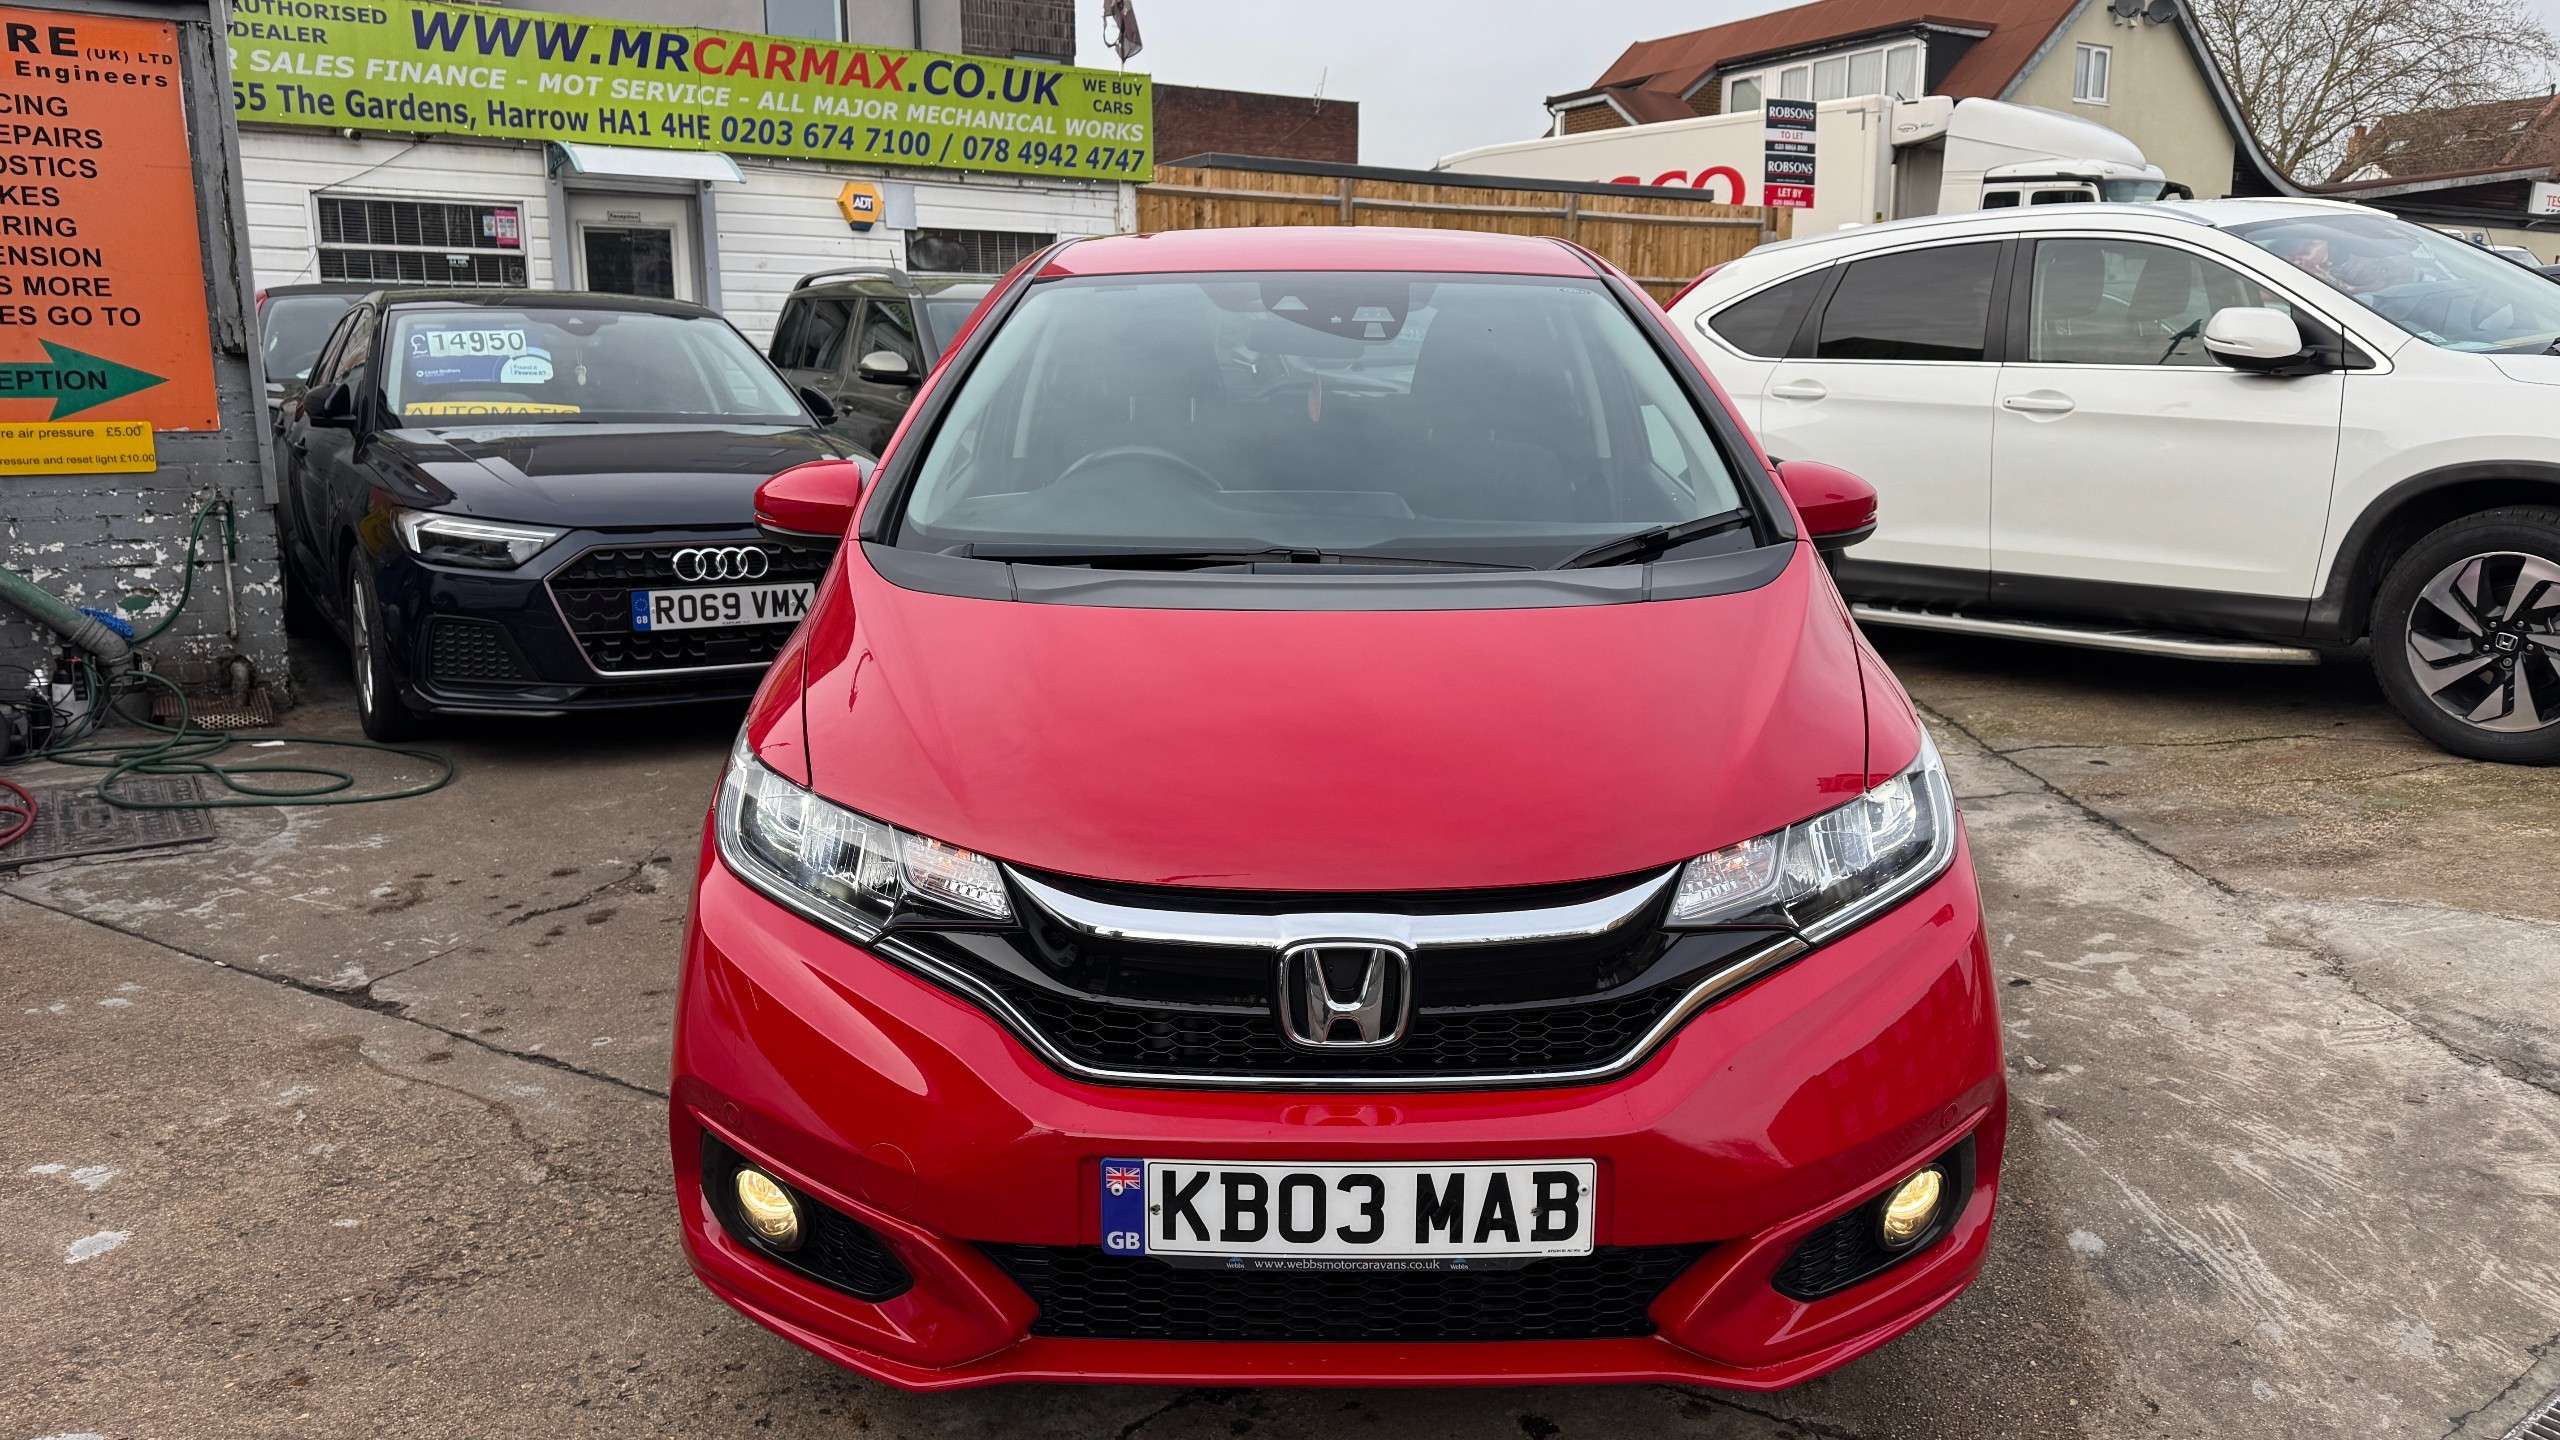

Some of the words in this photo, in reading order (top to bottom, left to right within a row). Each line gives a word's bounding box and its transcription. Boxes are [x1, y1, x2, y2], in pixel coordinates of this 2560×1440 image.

[232, 0, 387, 25] AUTHORISED
[233, 21, 328, 44] DEALER
[6, 22, 79, 58] RE
[86, 48, 129, 64] (UK)
[138, 53, 173, 65] LTD
[412, 9, 1064, 106] WWW.MRCARMAX.CO.UK
[15, 60, 168, 87] Engineers
[250, 49, 355, 78] SALES
[366, 58, 507, 90] FINANCE
[538, 72, 604, 97] MOT
[610, 78, 731, 107] SERVICE
[756, 91, 805, 113] ALL
[813, 95, 898, 121] MAJOR
[906, 104, 1057, 135] MECHANICAL
[1065, 118, 1144, 142] WORKS
[1082, 78, 1107, 93] WE
[1112, 82, 1142, 96] BUY
[0, 93, 68, 117] CING
[1093, 99, 1133, 115] CARS
[1769, 106, 1814, 120] ROBSONS
[0, 124, 103, 149] EPAIRS
[232, 81, 266, 111] 55
[276, 84, 335, 115] The
[345, 89, 477, 131] Gardens,
[487, 100, 589, 132] Harrow
[598, 107, 651, 136] HA1
[661, 112, 711, 140] 4HE
[721, 116, 794, 146] 0203
[803, 123, 855, 151] 674
[865, 127, 931, 156] 7100
[963, 135, 1010, 163] 078
[1017, 141, 1078, 168] 4942
[1085, 146, 1145, 172] 4747
[1780, 130, 1790, 139] TO
[1792, 131, 1804, 140] LET
[1767, 160, 1813, 175] ROBSONS
[0, 184, 60, 207] KES
[1777, 187, 1791, 197] LET
[853, 196, 873, 210] ADT
[2, 215, 77, 237] RING
[22, 276, 113, 297] MORE
[0, 305, 37, 326] ES
[47, 306, 93, 326] GO
[101, 307, 141, 327] TO
[0, 370, 108, 391] EPTION
[18, 428, 34, 439] air
[39, 428, 95, 441] pressure
[106, 426, 142, 438] £5.00
[43, 454, 63, 465] and
[66, 454, 93, 465] reset
[95, 453, 118, 466] light
[120, 453, 155, 464] £10.00
[654, 593, 741, 624] RO69
[751, 588, 809, 618] VMX
[636, 615, 648, 625] GB
[1162, 1170, 1385, 1244] KB03
[1415, 1170, 1580, 1244] MAB
[1106, 1231, 1140, 1250] GB
[1254, 1259, 1440, 1271] www.webbsmotorcaravans.co.uk
